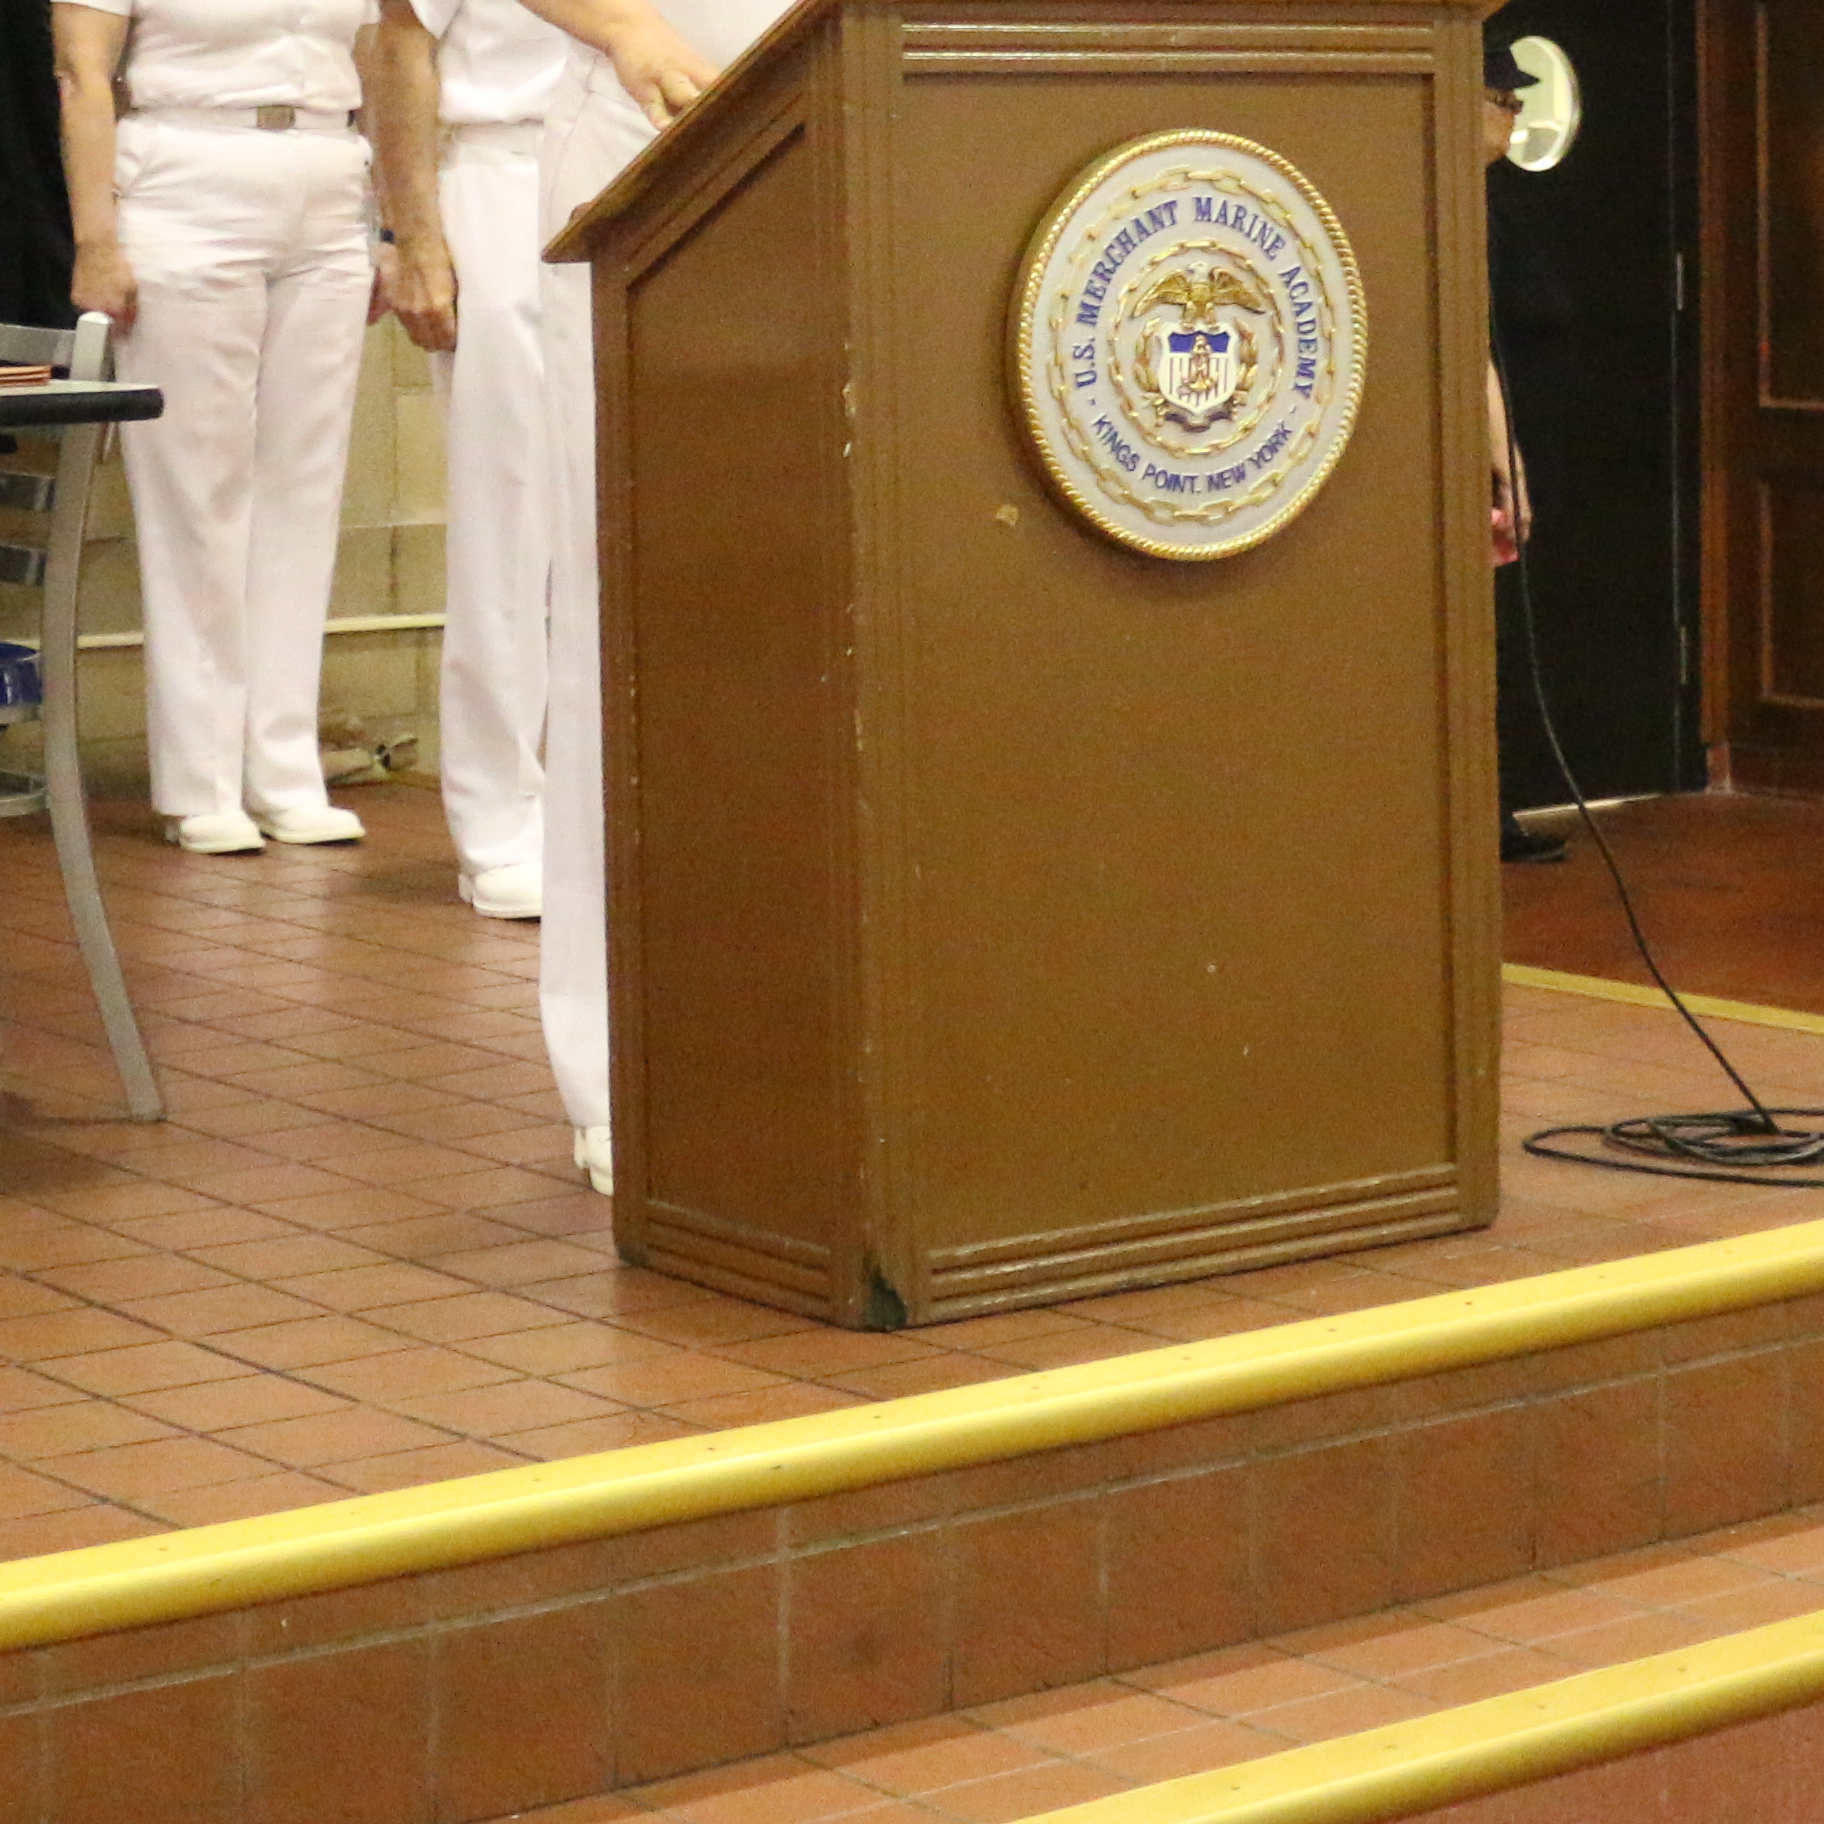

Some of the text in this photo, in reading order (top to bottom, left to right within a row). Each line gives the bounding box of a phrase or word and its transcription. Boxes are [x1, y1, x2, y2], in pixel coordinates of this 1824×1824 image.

[1073, 196, 1319, 399] U.S. MERCHANT MARINE ACADEMY
[1093, 413, 1140, 472] KINGS
[1207, 462, 1246, 493] NEW
[1247, 420, 1294, 470] YORK
